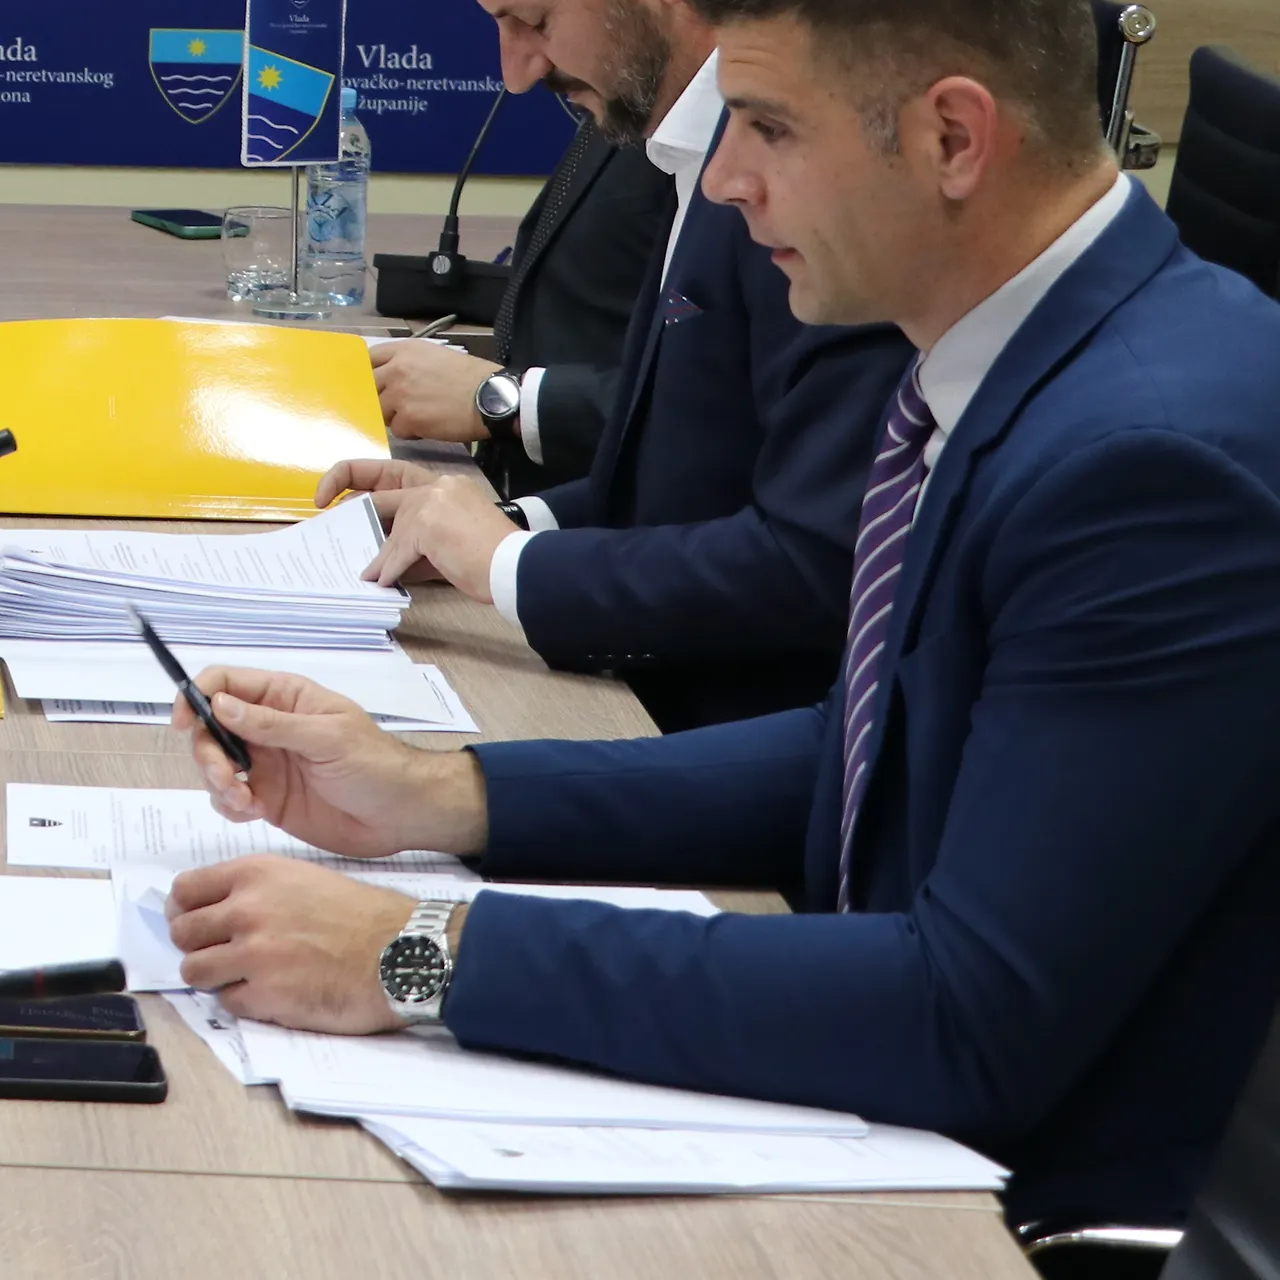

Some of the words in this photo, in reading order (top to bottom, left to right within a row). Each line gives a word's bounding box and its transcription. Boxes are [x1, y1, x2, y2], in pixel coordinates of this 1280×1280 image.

[356, 44, 433, 70] Vlada
[342, 74, 503, 93] ovačko-neretvanske
[357, 97, 428, 114] županije
